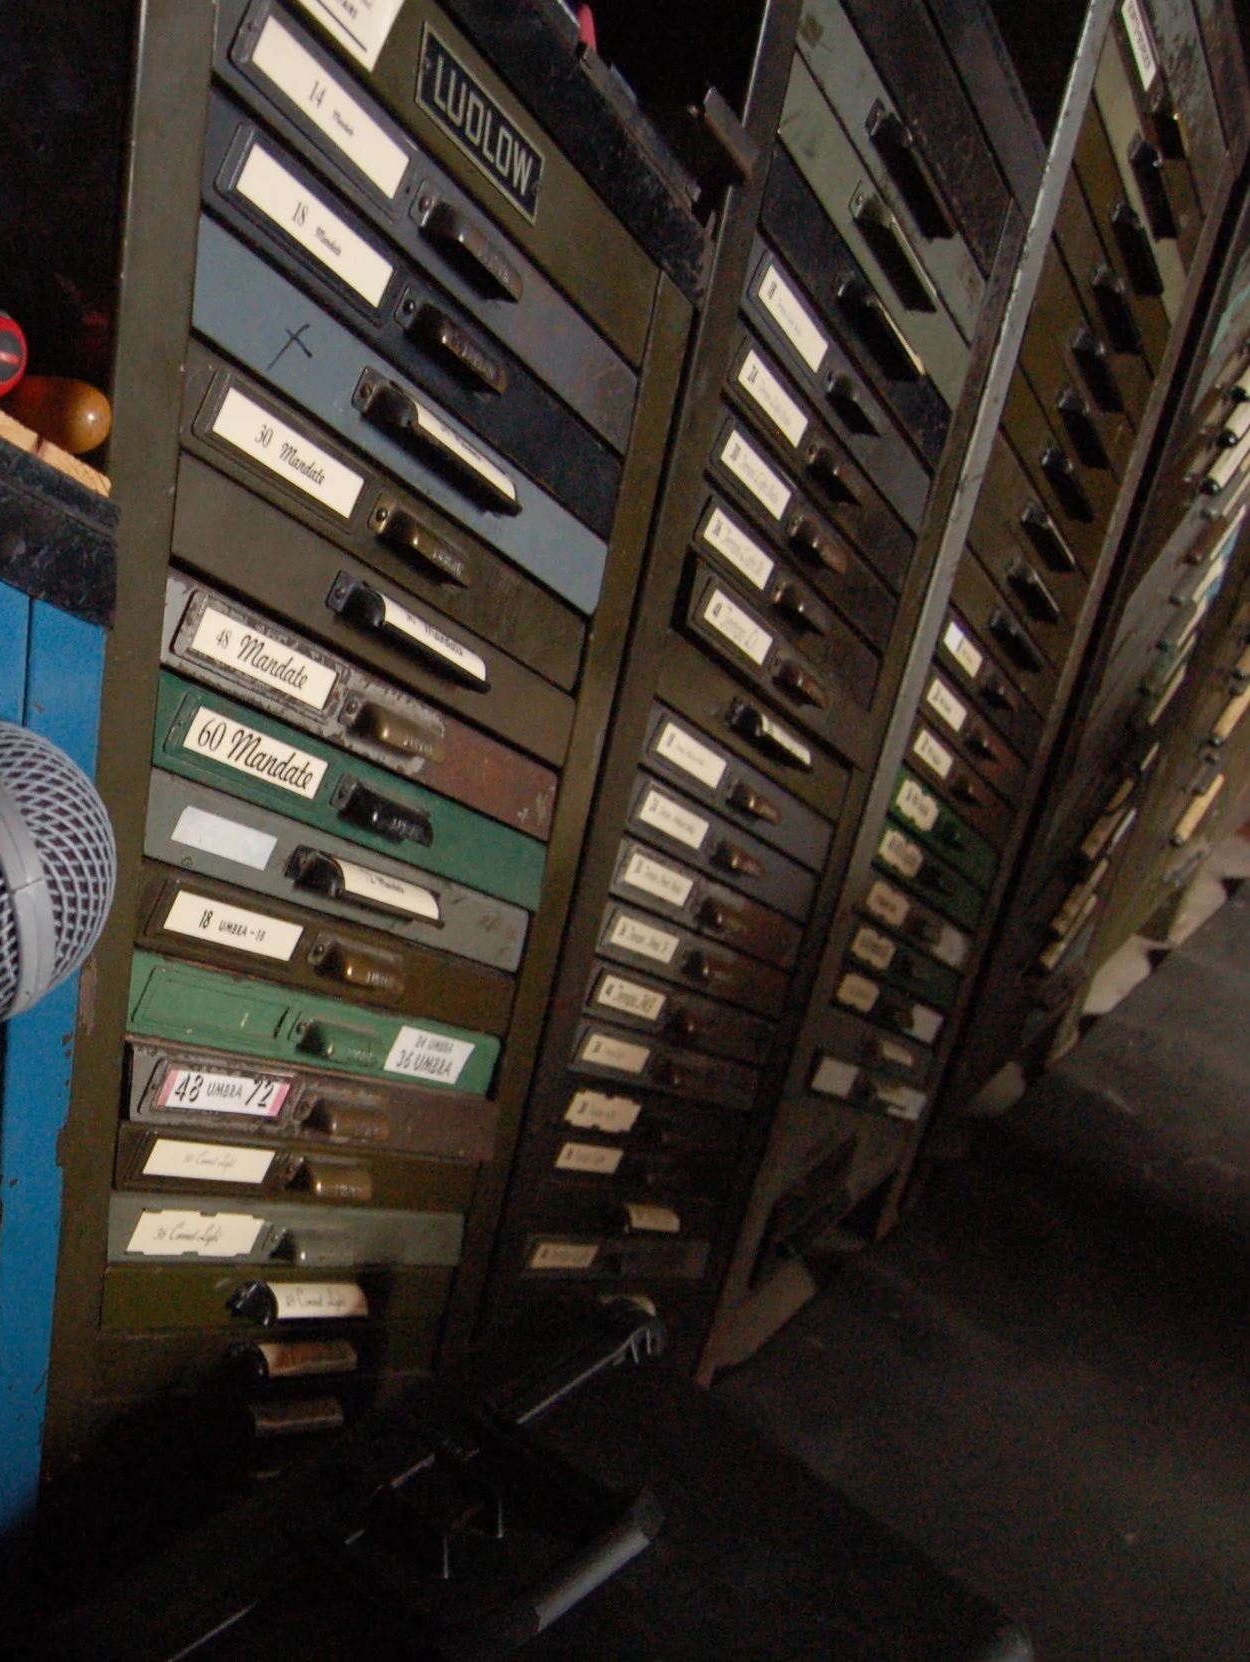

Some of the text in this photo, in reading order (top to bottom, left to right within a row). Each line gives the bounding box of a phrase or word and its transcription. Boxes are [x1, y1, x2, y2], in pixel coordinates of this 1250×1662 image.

[432, 55, 536, 198] LUDLOW
[291, 200, 310, 228] 18
[252, 423, 327, 488] 30 Mandate
[214, 623, 309, 691] 48 Mandate
[196, 719, 316, 792] 60 Mandate
[198, 908, 214, 930] 18
[218, 919, 248, 938] UMBRA
[395, 1048, 415, 1072] 36
[413, 1051, 455, 1079] UMBRA
[174, 1073, 276, 1108] 48 UMBRA 72
